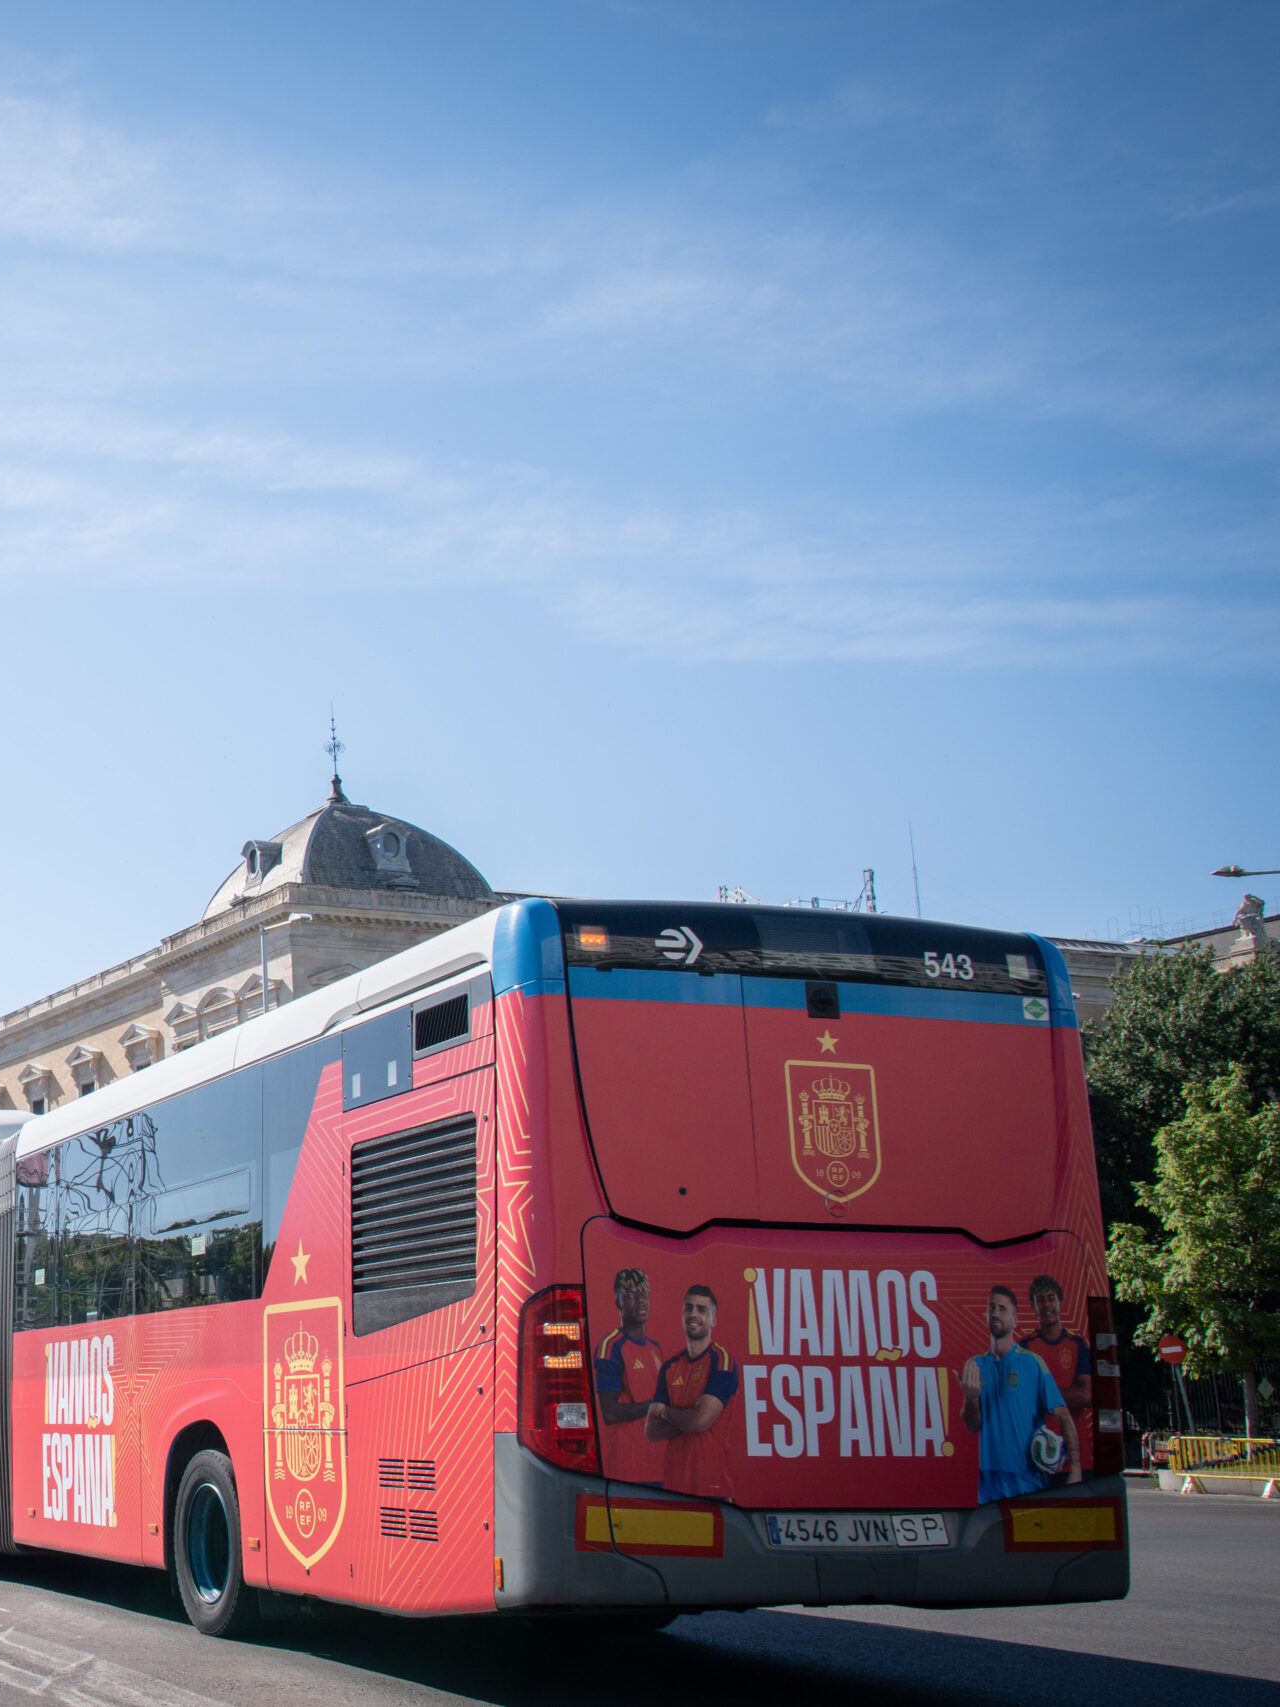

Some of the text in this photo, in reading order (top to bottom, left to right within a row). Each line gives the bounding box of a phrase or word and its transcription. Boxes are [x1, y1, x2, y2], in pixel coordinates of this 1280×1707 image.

[924, 952, 974, 980] 543
[299, 1501, 311, 1511] RF
[300, 1515, 312, 1525] EF
[784, 1519, 889, 1542] 4546 JVN
[899, 1518, 938, 1542] SP
